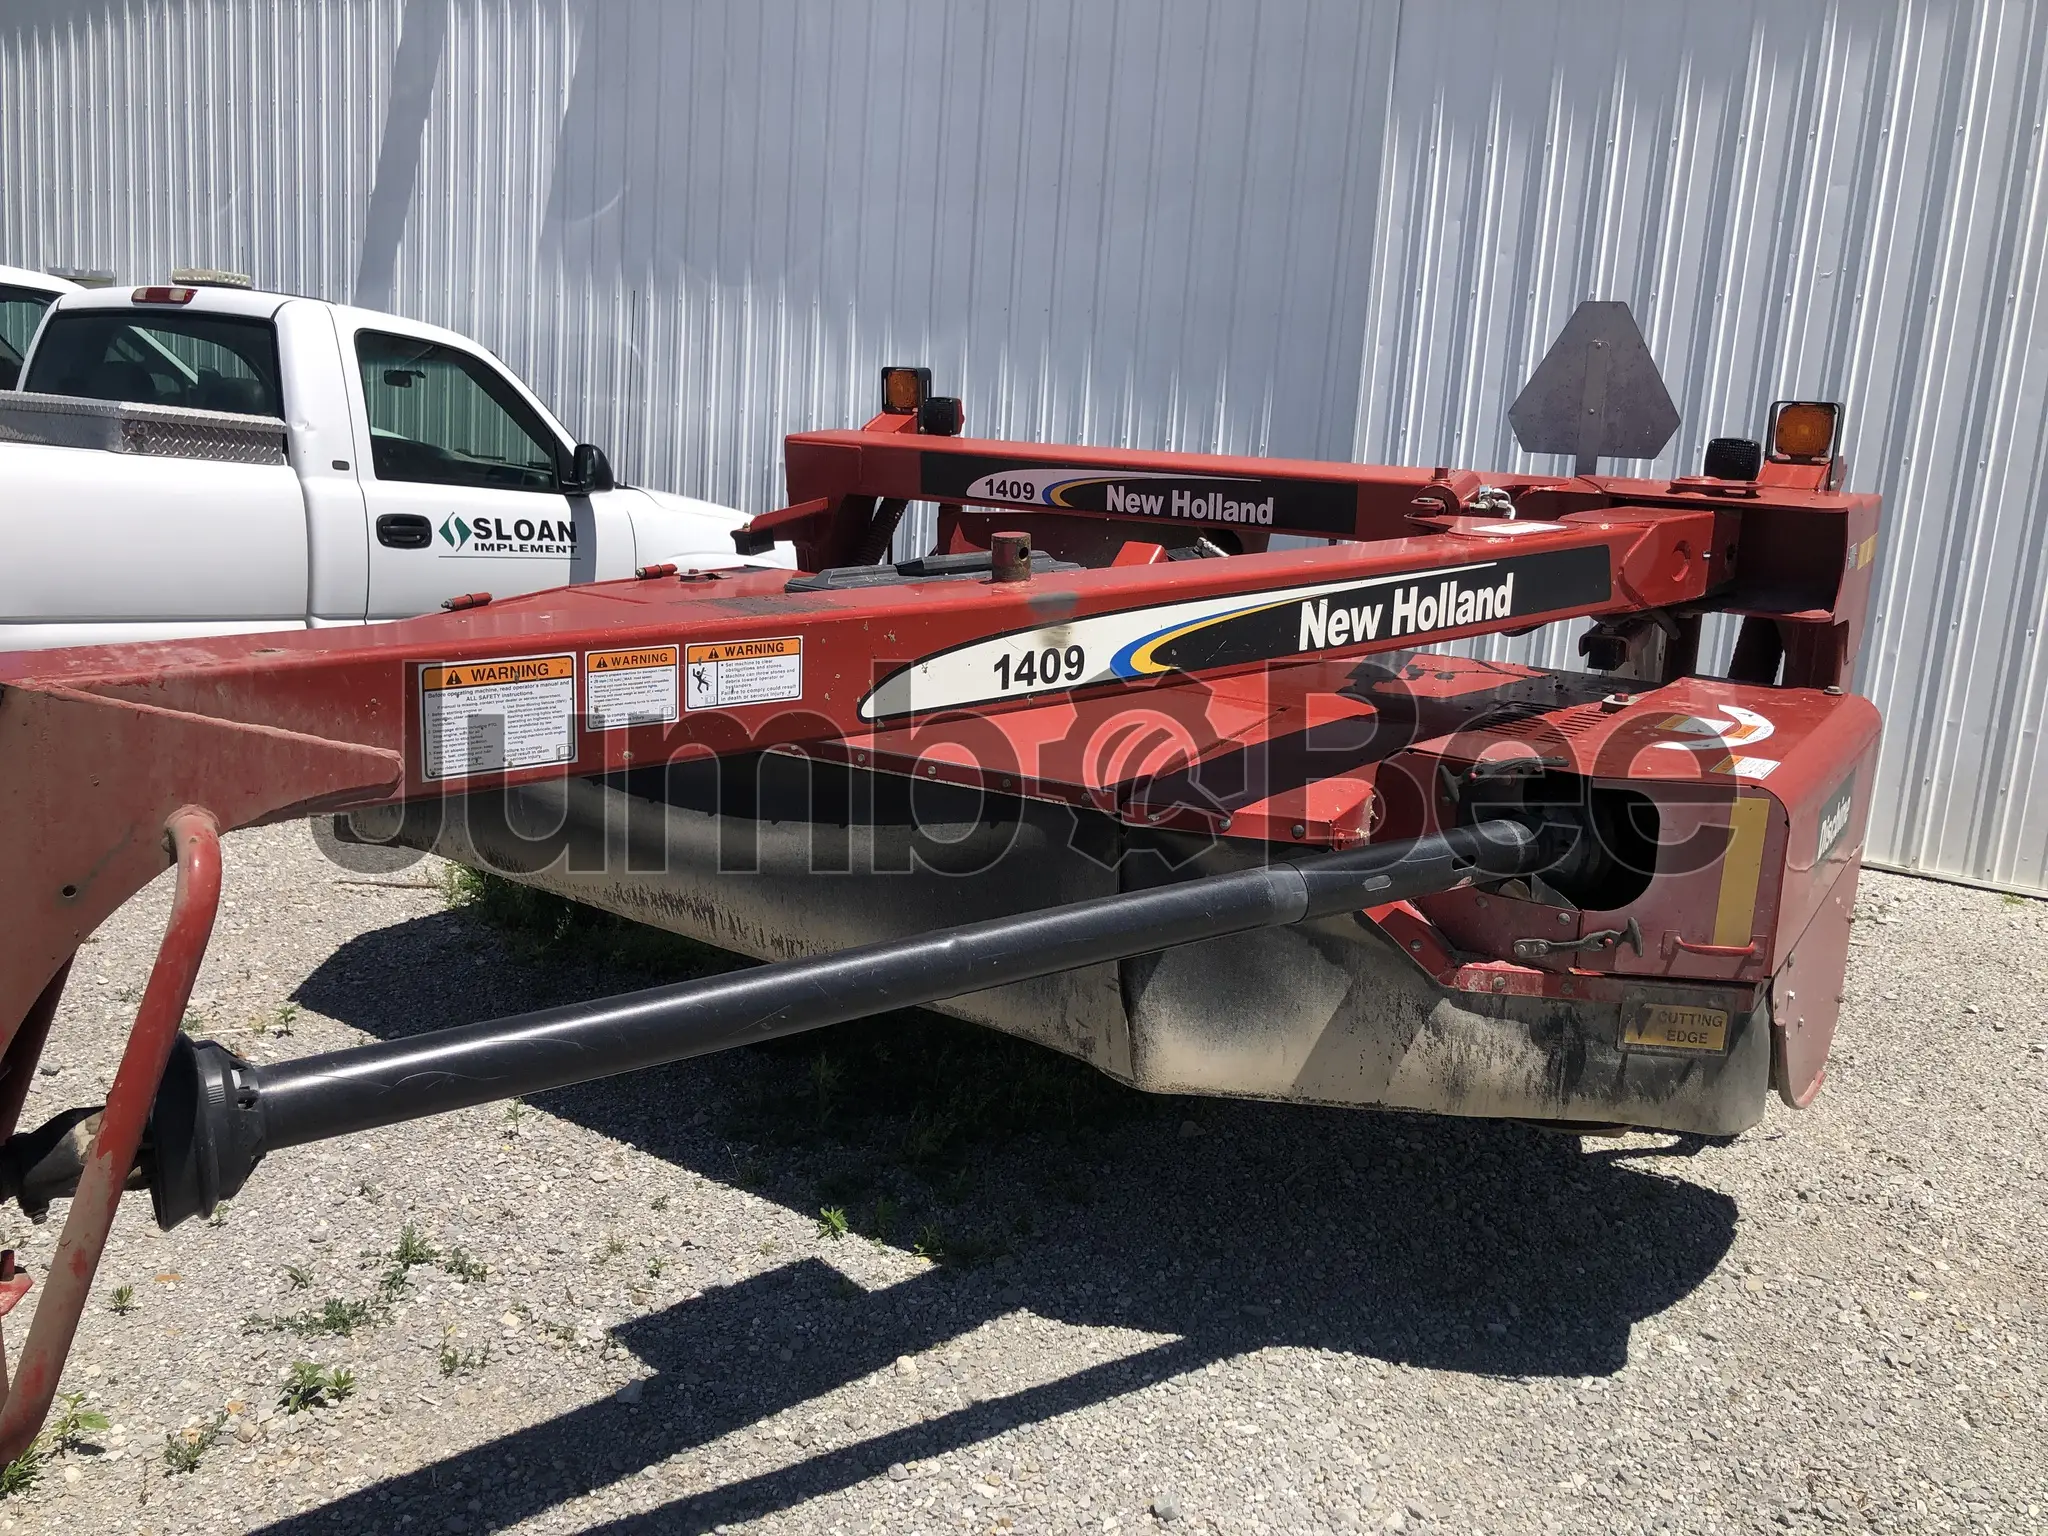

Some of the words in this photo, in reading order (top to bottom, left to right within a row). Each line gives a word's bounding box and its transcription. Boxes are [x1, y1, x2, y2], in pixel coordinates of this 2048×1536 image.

[985, 479, 1035, 500] 1409
[1106, 484, 1164, 515] New
[1171, 489, 1274, 525] Holland
[473, 517, 577, 543] SLOAN
[474, 543, 578, 554] IMPLEMENT
[993, 645, 1085, 691] 1409
[1298, 598, 1385, 652] New
[1390, 573, 1514, 637] Holland
[725, 642, 783, 656] WARNING
[611, 652, 667, 666] WARNING
[471, 662, 548, 681] WARNING
[1657, 1010, 1723, 1028] CUTTING
[1666, 1029, 1709, 1044] EDGE
